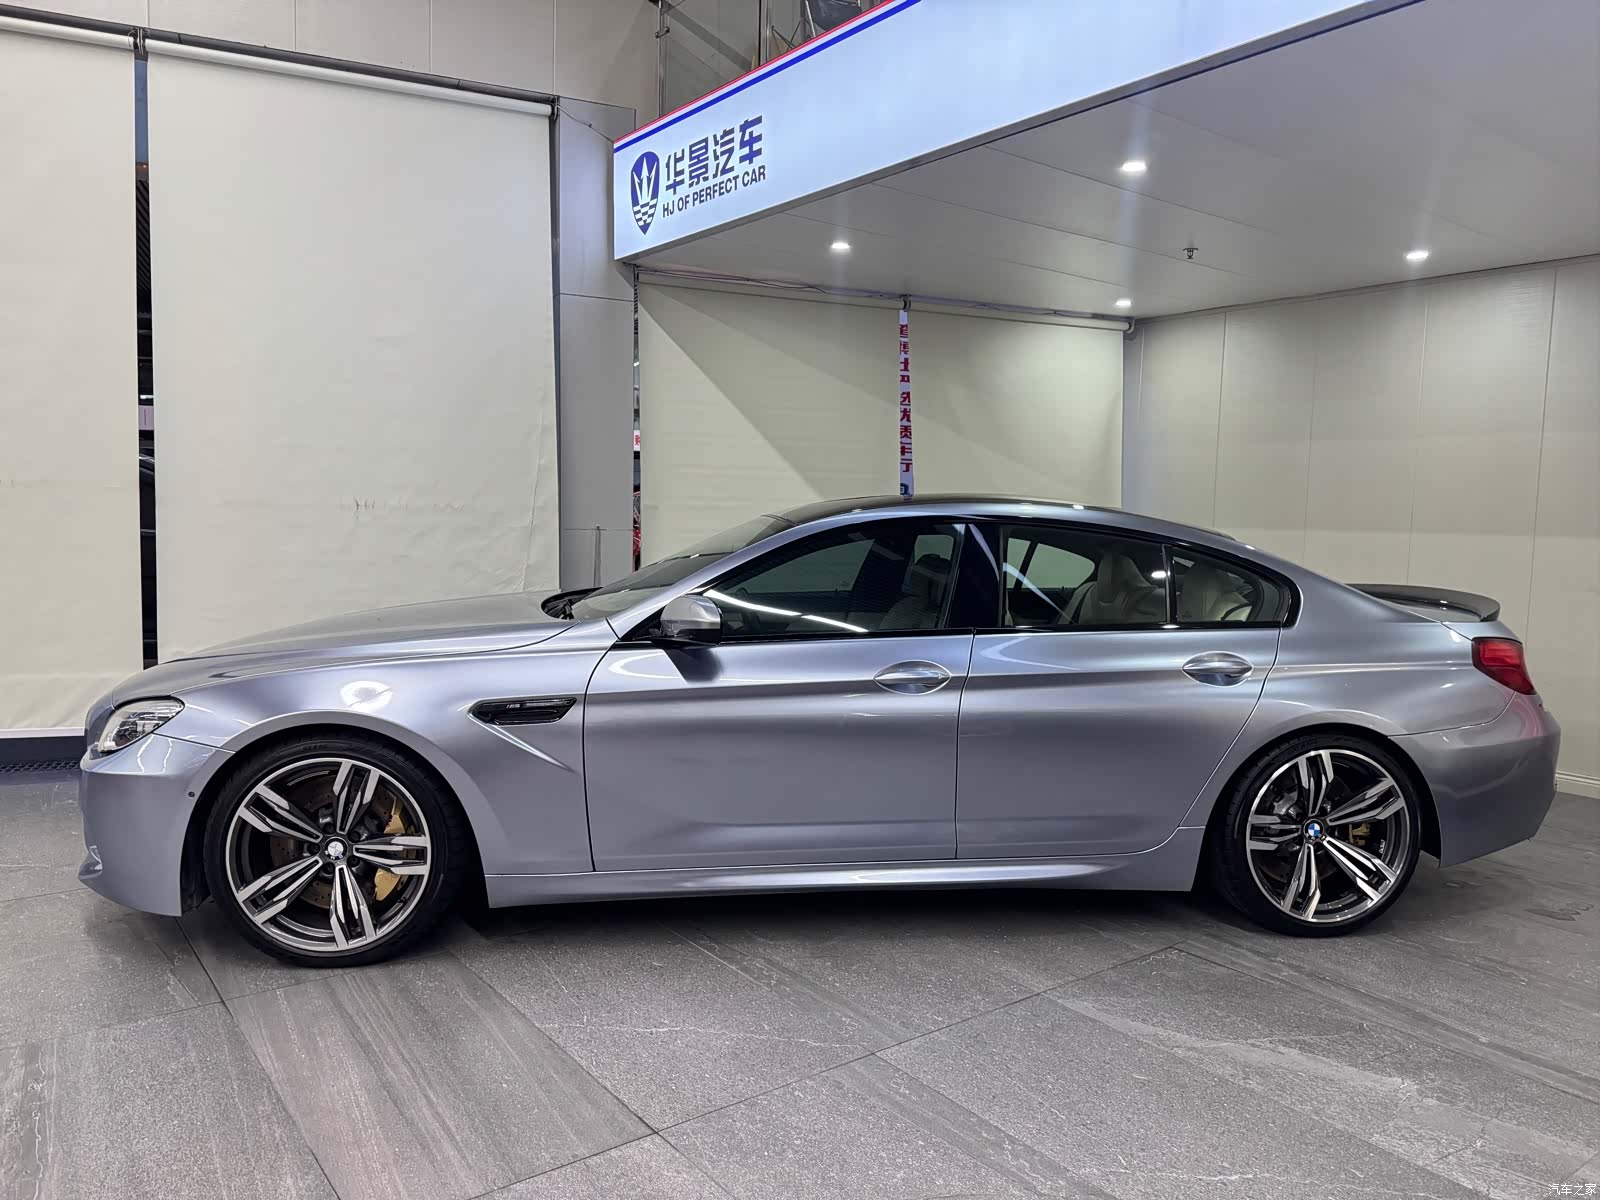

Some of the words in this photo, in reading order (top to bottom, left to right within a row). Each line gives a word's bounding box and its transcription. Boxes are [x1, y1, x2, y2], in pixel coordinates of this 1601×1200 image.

[665, 115, 763, 195] 华景汽车
[662, 202, 675, 218] HJ
[677, 194, 690, 212] OF
[692, 174, 740, 207] PERFECT
[741, 164, 766, 188] CAR
